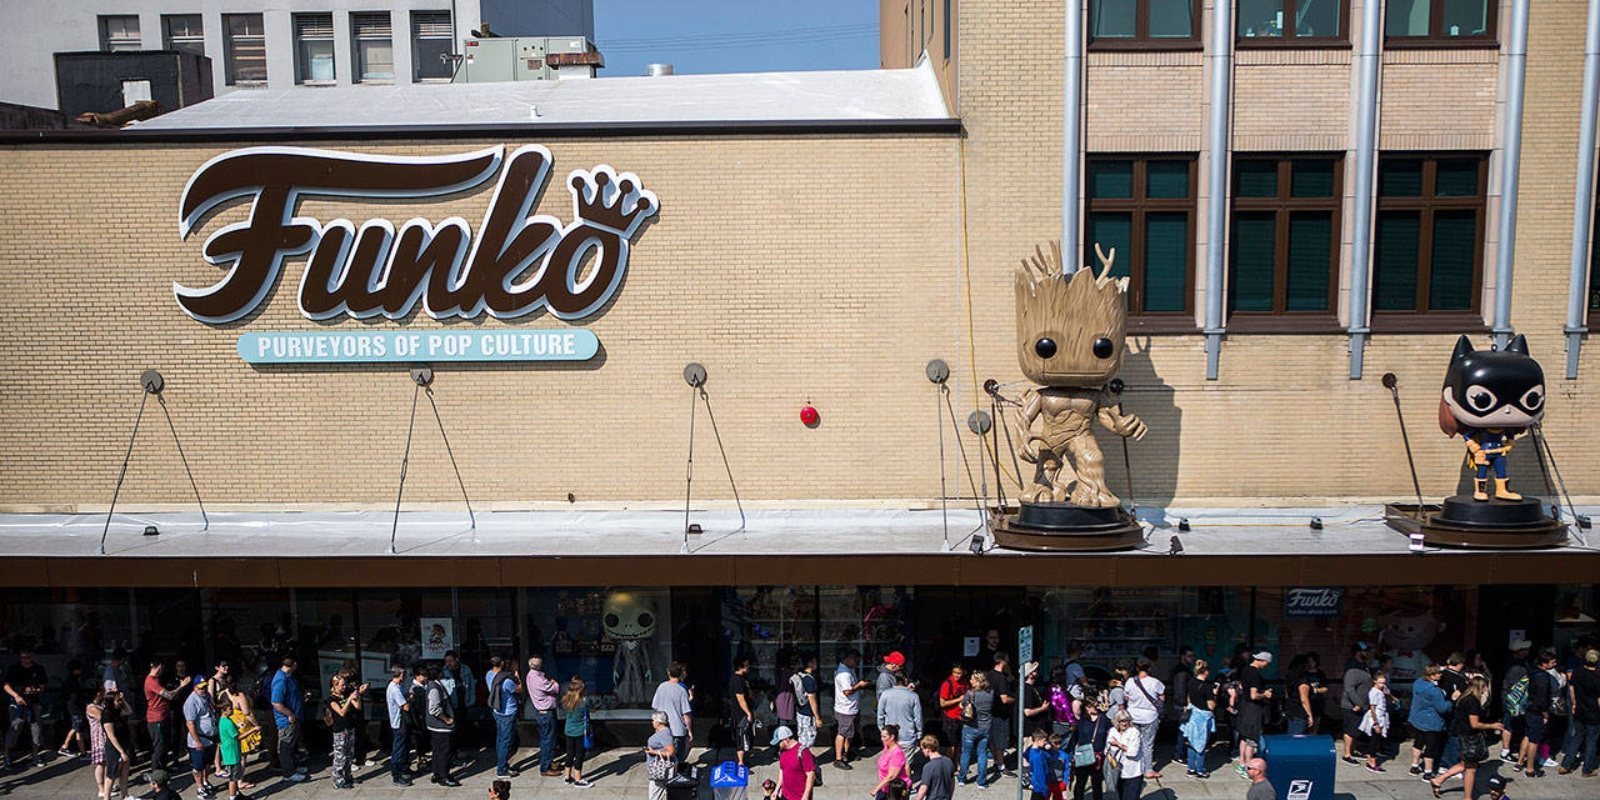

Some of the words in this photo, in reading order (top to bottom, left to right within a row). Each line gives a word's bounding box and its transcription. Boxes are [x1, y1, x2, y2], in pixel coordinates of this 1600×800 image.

[174, 144, 632, 321] Funko
[257, 336, 386, 357] PURVEYORS
[394, 335, 421, 356] OF
[428, 334, 472, 356] POP
[480, 334, 576, 356] CULTURE
[1287, 588, 1338, 607] Funko
